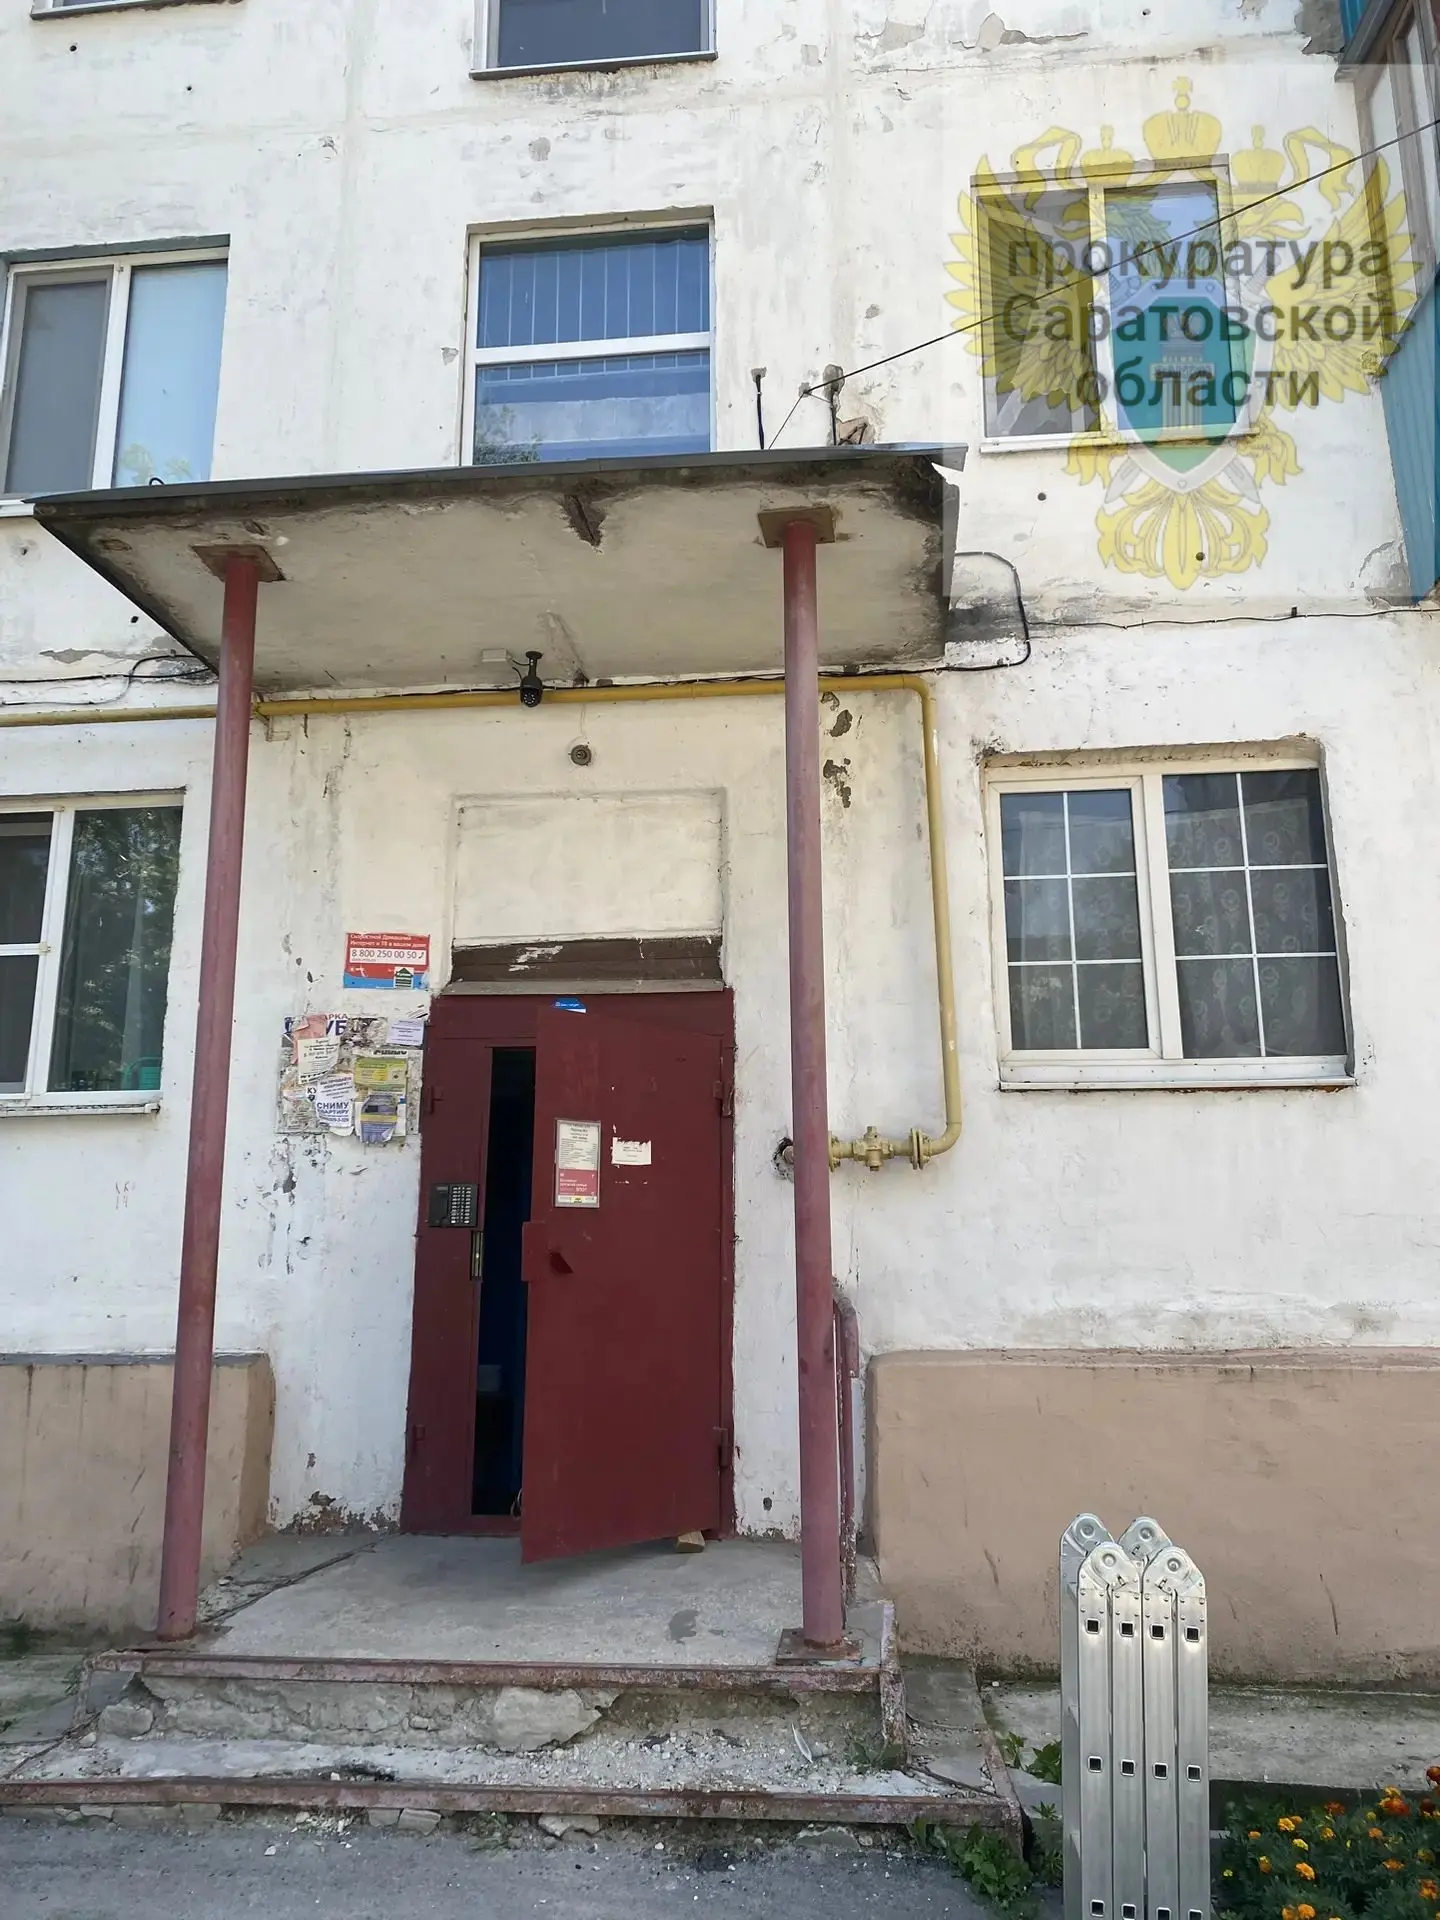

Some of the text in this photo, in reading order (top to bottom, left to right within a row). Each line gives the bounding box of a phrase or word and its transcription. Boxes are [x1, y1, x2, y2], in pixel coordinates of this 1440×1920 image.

[351, 949, 417, 959] 8 800 250 00 50
[316, 1102, 349, 1110] СНИМУ
